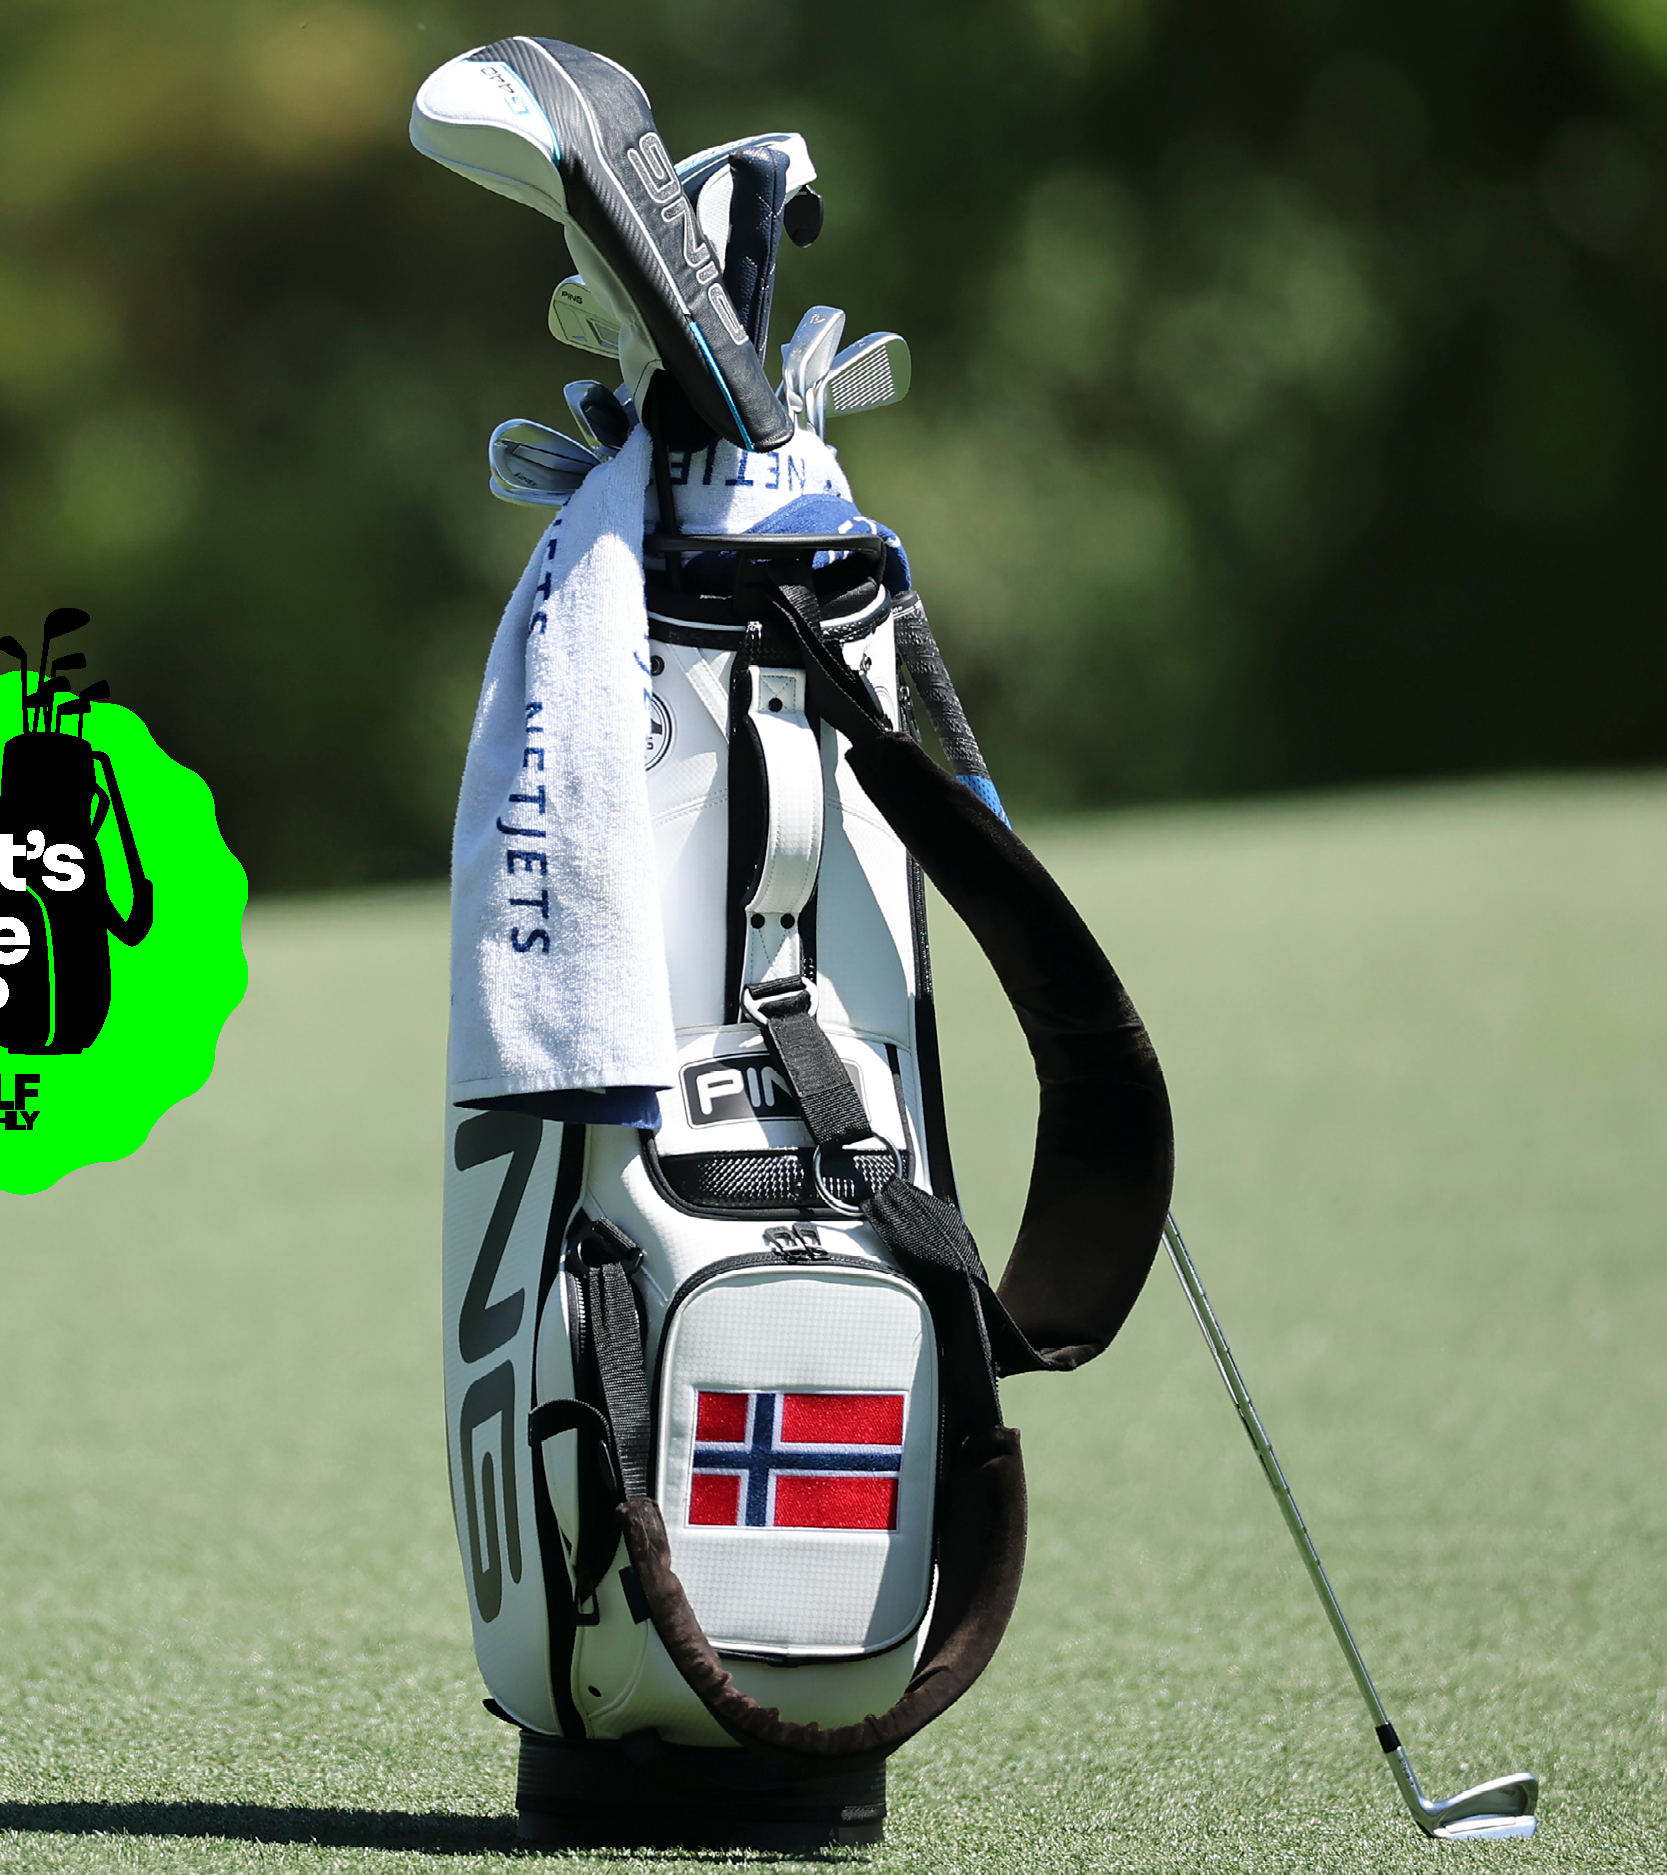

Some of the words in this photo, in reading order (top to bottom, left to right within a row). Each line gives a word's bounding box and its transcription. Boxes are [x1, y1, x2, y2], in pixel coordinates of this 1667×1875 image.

[561, 290, 583, 305] PING
[627, 132, 750, 346] PING
[496, 702, 550, 954] NETJETS
[696, 1066, 796, 1116] PIN
[454, 1110, 543, 1623] NG
